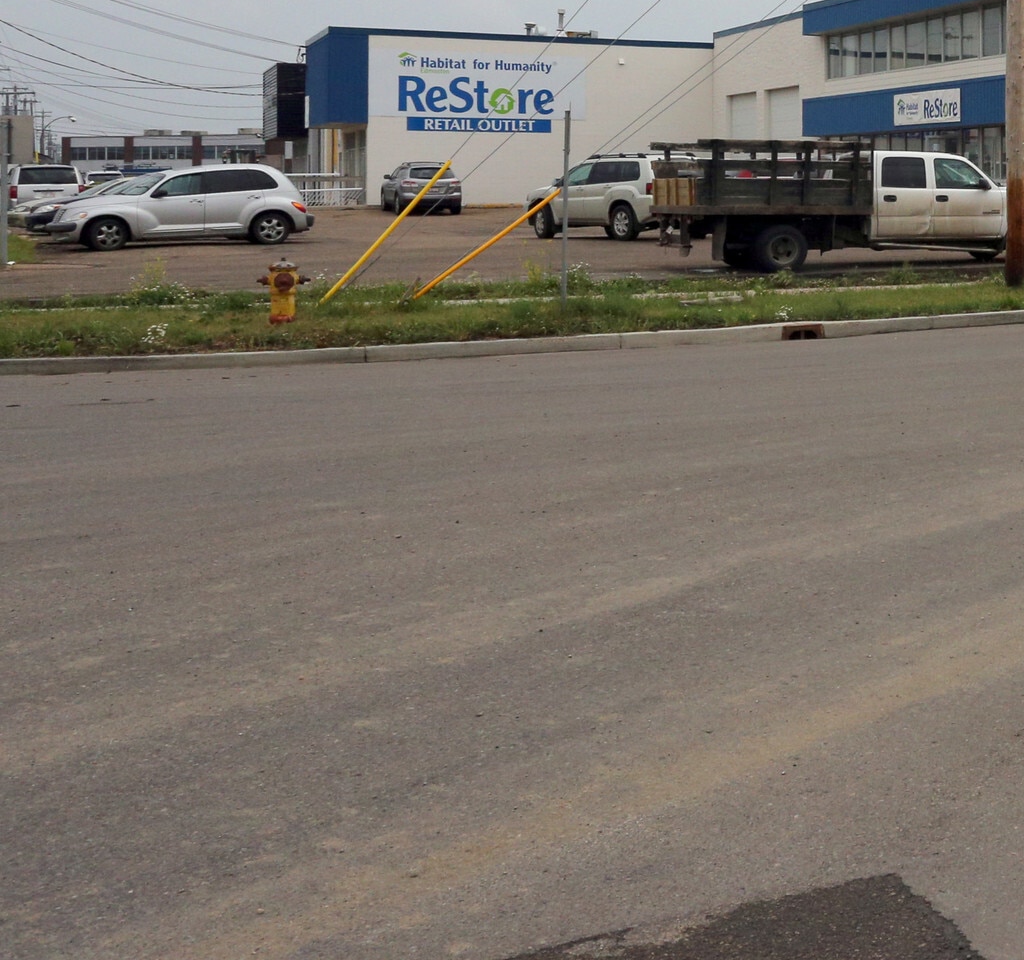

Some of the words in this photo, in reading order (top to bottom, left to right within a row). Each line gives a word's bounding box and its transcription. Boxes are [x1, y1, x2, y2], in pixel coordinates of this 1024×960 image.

[420, 56, 466, 70] Habitat
[473, 58, 491, 70] for
[494, 59, 552, 75] Humanity
[397, 75, 555, 115] ReStore
[923, 97, 959, 119] ReStore
[424, 118, 474, 131] RETAIL
[478, 120, 536, 132] OUTLET
